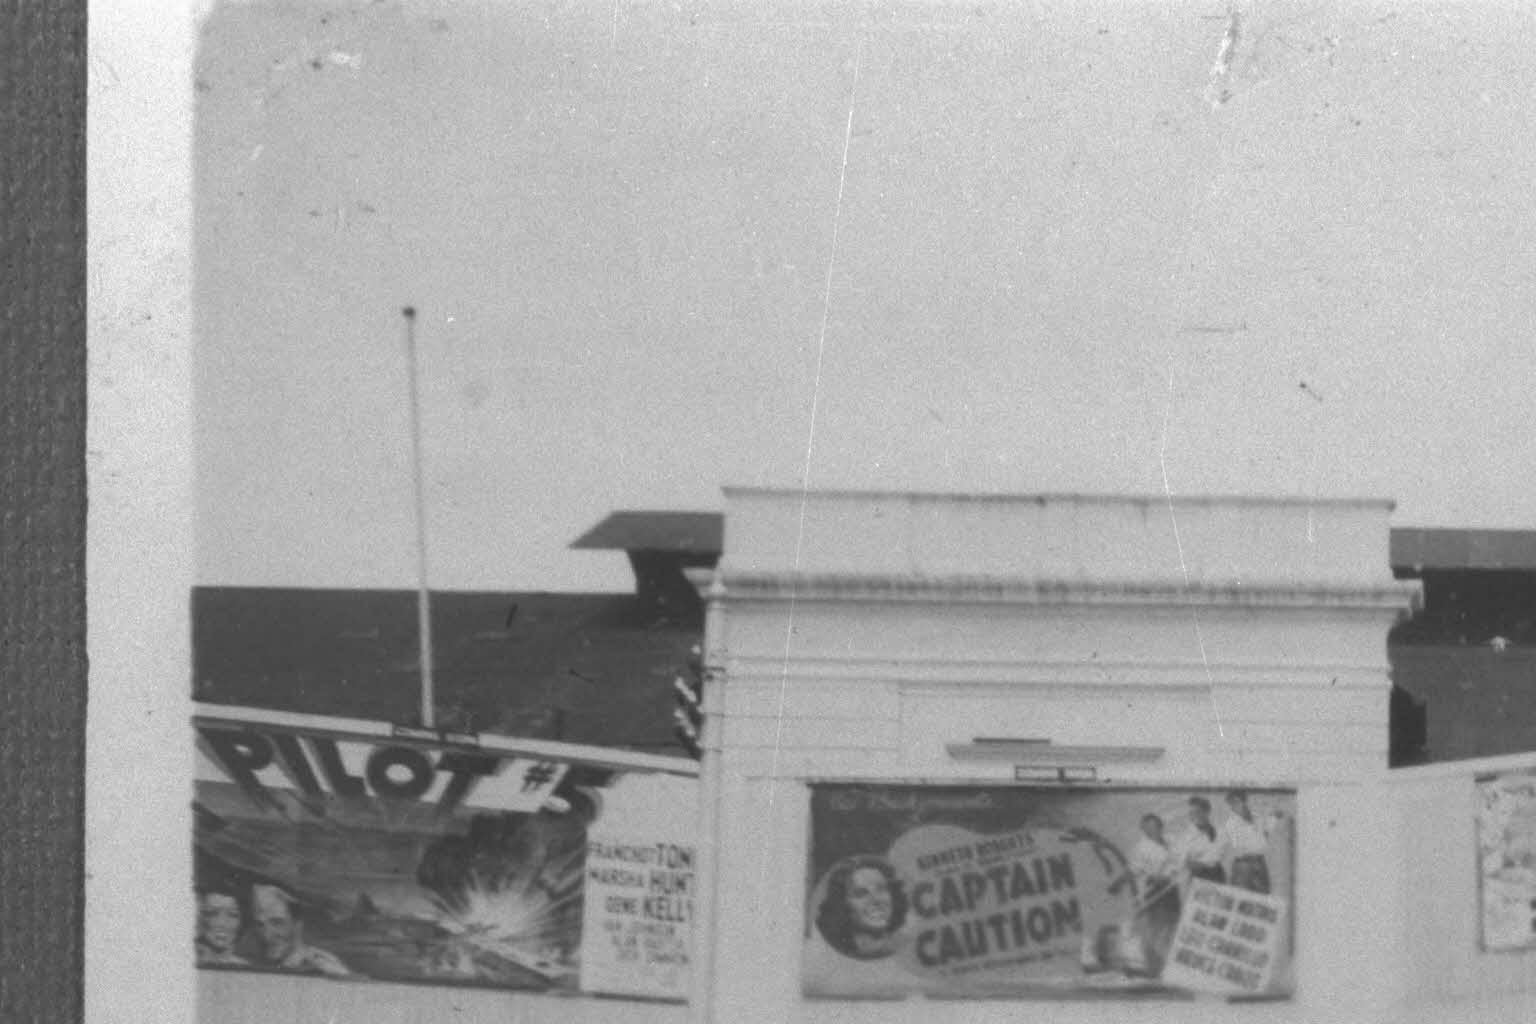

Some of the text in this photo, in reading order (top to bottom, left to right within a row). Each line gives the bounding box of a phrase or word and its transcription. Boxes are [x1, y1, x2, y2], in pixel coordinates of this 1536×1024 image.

[200, 726, 503, 816] PILOT
[912, 852, 1076, 919] CAPTAIN
[915, 897, 1083, 967] CAUTION
